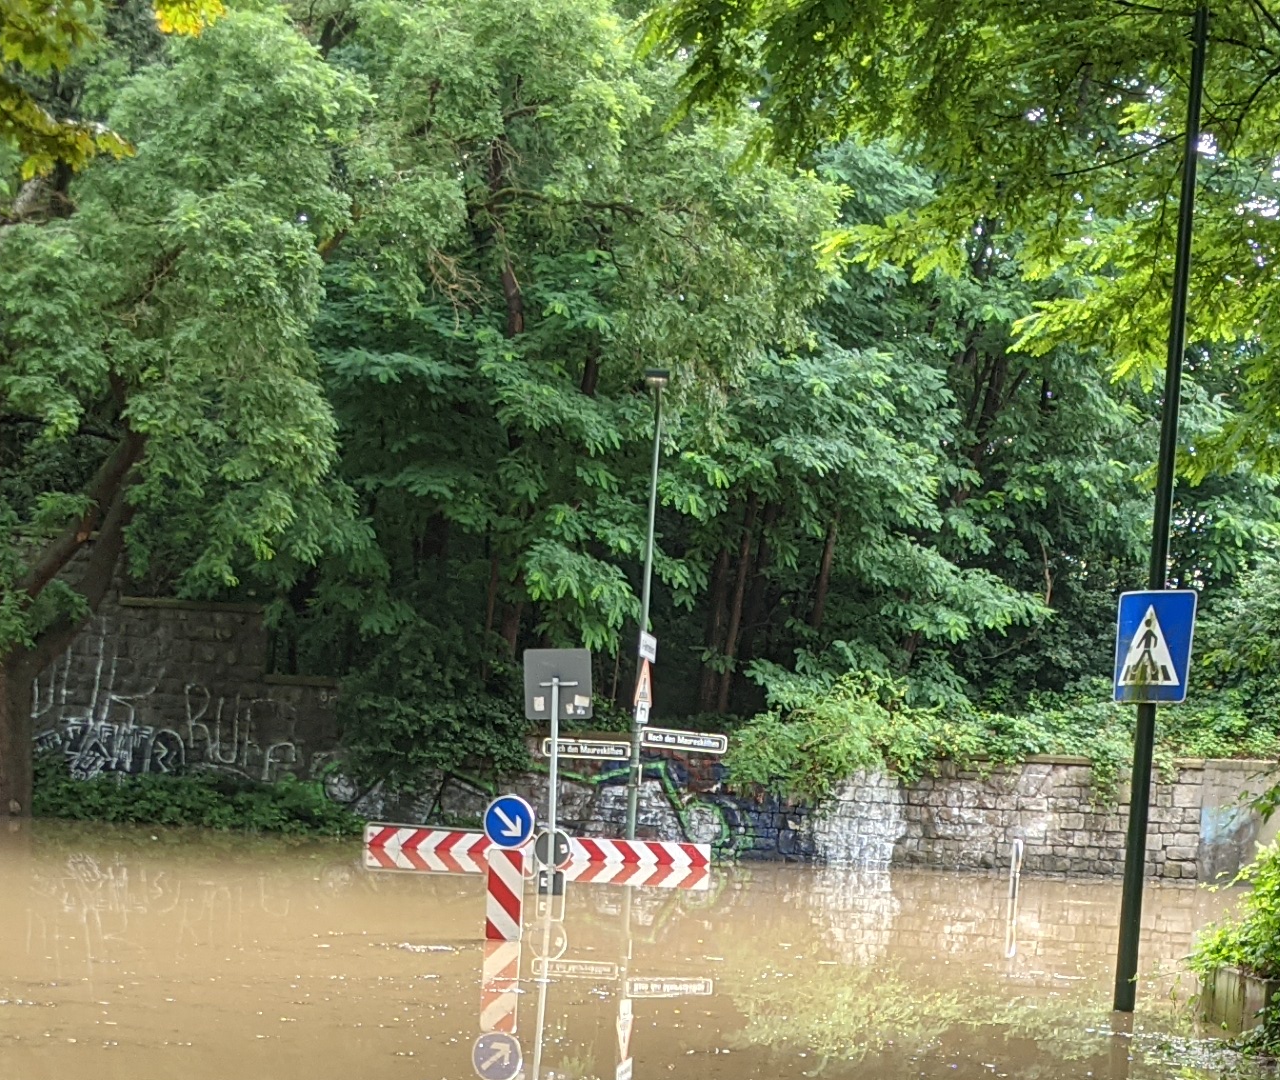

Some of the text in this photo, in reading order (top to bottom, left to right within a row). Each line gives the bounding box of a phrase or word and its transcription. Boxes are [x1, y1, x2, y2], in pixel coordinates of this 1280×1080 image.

[647, 733, 663, 742] Nach
[664, 734, 676, 744] den
[567, 745, 578, 753] den
